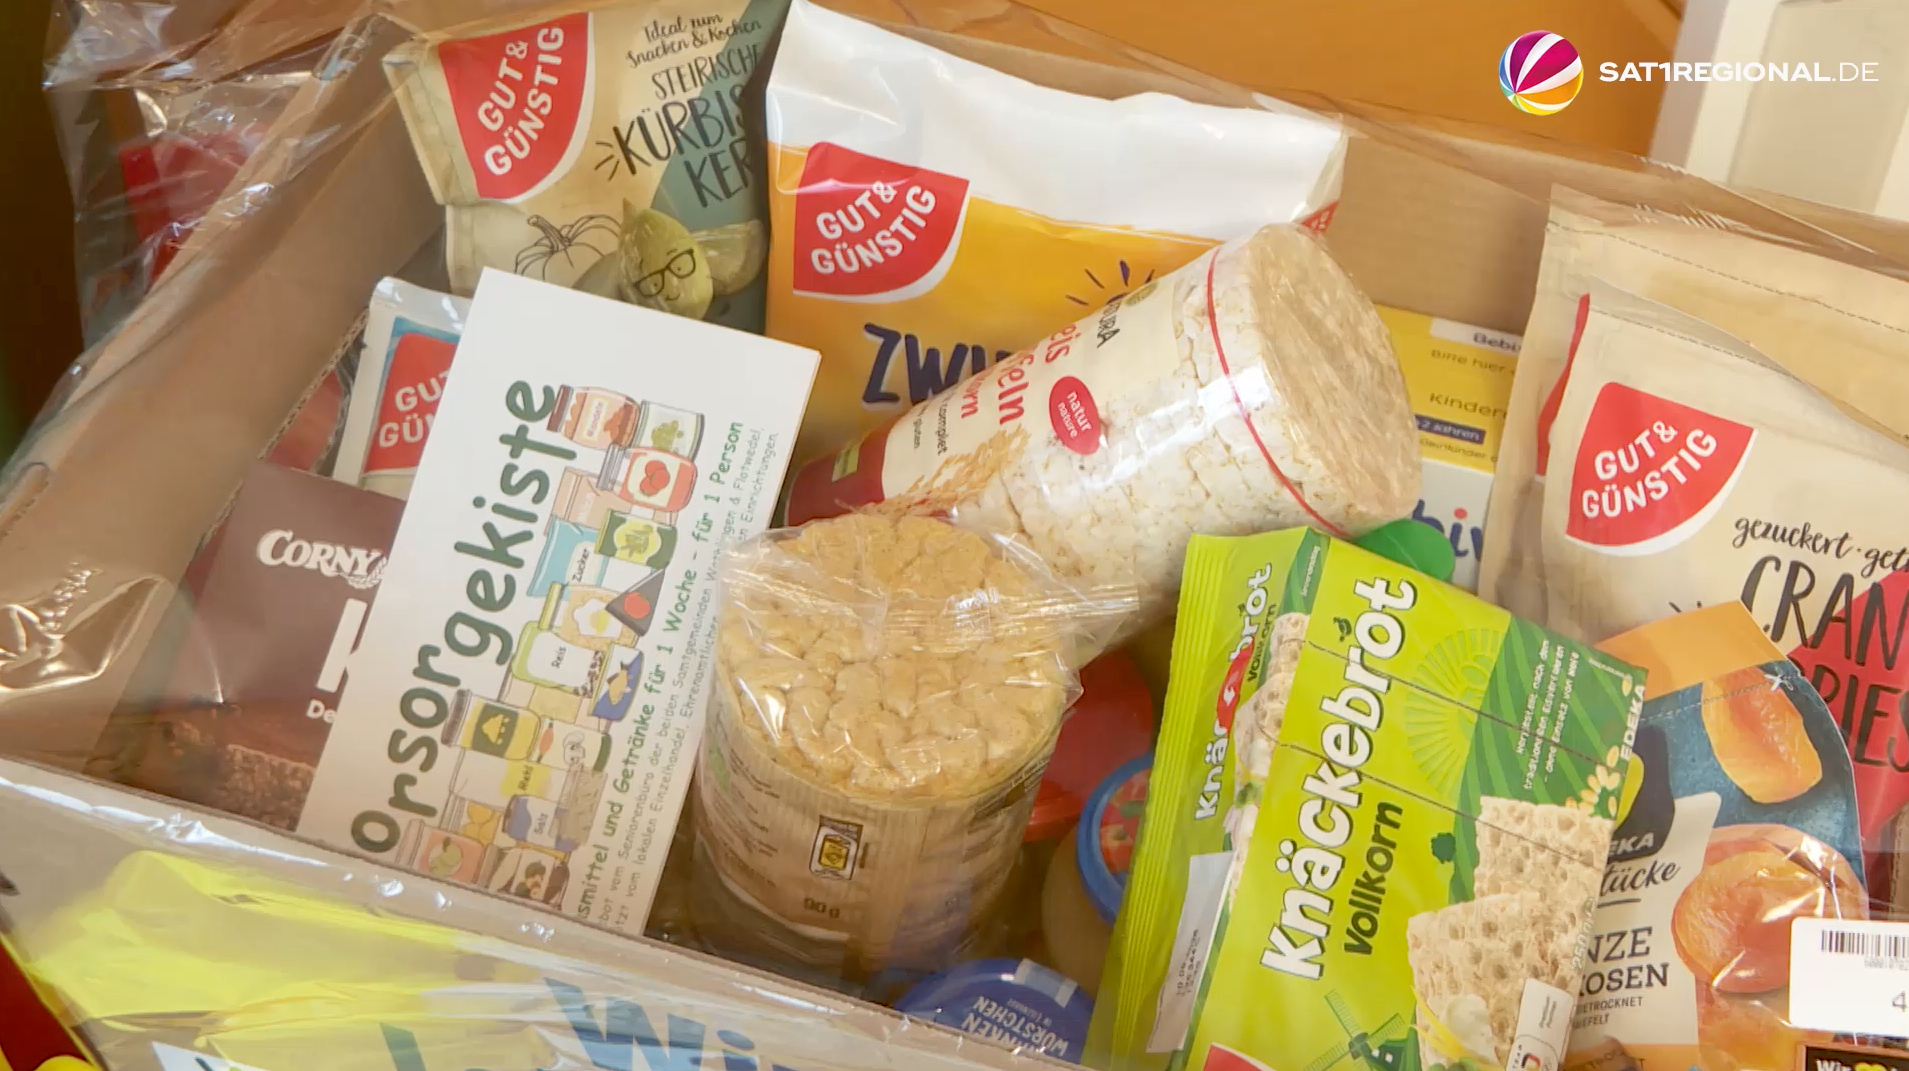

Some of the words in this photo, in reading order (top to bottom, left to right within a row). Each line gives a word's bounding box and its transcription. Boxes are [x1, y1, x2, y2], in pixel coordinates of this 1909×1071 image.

[626, 40, 689, 68] Snacken
[709, 18, 762, 43] Kochen
[644, 15, 687, 43] Ideal
[691, 14, 723, 28] zum
[484, 26, 565, 176] GÜNSTIG
[810, 185, 936, 275] GÜNSTIG
[862, 322, 1013, 407] ZWI
[1056, 402, 1078, 440] nature
[1065, 390, 1092, 434] natur
[709, 422, 743, 485] Person
[1581, 427, 1718, 518] GÜNSTIG
[704, 494, 720, 504] 1
[691, 512, 714, 543] für
[1731, 516, 1854, 560] gezuckert
[571, 548, 591, 583] Zucker
[351, 379, 558, 853] orsorgekiste
[662, 569, 697, 632] Woche
[551, 646, 568, 669] Reis
[656, 644, 674, 654] 1
[644, 664, 666, 694] für
[1620, 684, 1647, 761] EDEKA
[613, 704, 655, 793] Getränke
[1260, 576, 1418, 981] Knäckebrot
[602, 800, 624, 837] und
[577, 844, 610, 920] smittel
[1343, 801, 1404, 956] Vollkorn
[1579, 962, 1670, 997] OSEN
